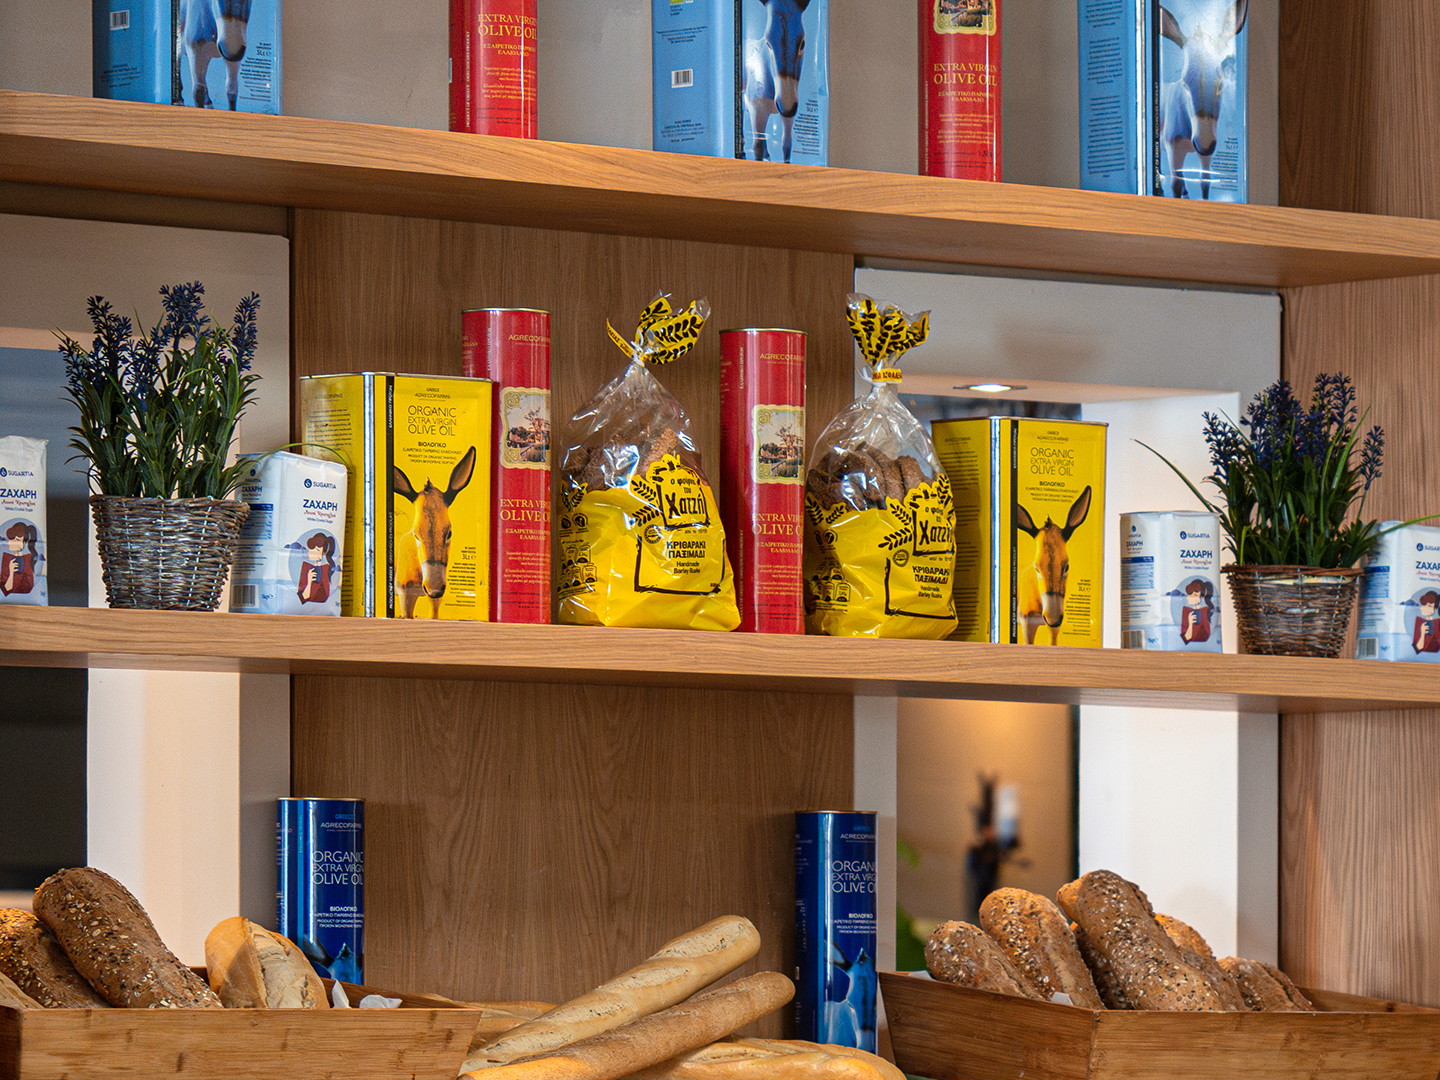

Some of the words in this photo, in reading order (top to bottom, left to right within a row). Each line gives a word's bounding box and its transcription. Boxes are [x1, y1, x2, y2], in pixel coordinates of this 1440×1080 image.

[478, 13, 513, 23] EXTRA
[515, 14, 536, 26] VIRG
[477, 24, 522, 37] OLIVE
[933, 63, 966, 72] EXTRA
[933, 73, 976, 85] OLIVE
[978, 73, 998, 86] OIL
[407, 405, 457, 418] ORGANIC
[407, 416, 431, 424] EXTRA
[432, 417, 457, 426] VIRGIN
[407, 423, 437, 435] OLIVE
[438, 425, 456, 437] OIL
[1030, 447, 1075, 460] ORGANIC
[1030, 457, 1052, 465] EXTRA
[1052, 458, 1075, 467] VIRGIN
[1030, 464, 1056, 475] OLIVE
[1057, 466, 1074, 476] OIL
[313, 481, 337, 489] SUGARTIA
[0, 488, 37, 499] ΖΑΧΑΡΗ
[303, 499, 338, 511] ΖΑΧΑΡΗ
[500, 499, 534, 508] EXTRA
[665, 492, 705, 519] Χατζή
[500, 509, 542, 522] OLIVE
[753, 513, 785, 522] EXTRA
[752, 524, 794, 535] OLIVE
[666, 541, 706, 549] ΚΡΙΘΑΡΑΚΙ
[668, 550, 706, 559] ΠΑΞΙΜΑΔΙ
[1180, 549, 1213, 558] ΖΑΧΑΡΗ
[914, 574, 949, 584] ΠΑΞΙΜΑΔΙ
[312, 850, 364, 863] ORGANIC
[313, 864, 343, 872] EXTRA
[344, 864, 364, 873] VIRGN
[832, 860, 876, 872] ORGAN
[312, 872, 348, 885] OLIVE
[832, 872, 860, 881] EXTRA
[832, 881, 866, 893] OLIVE
